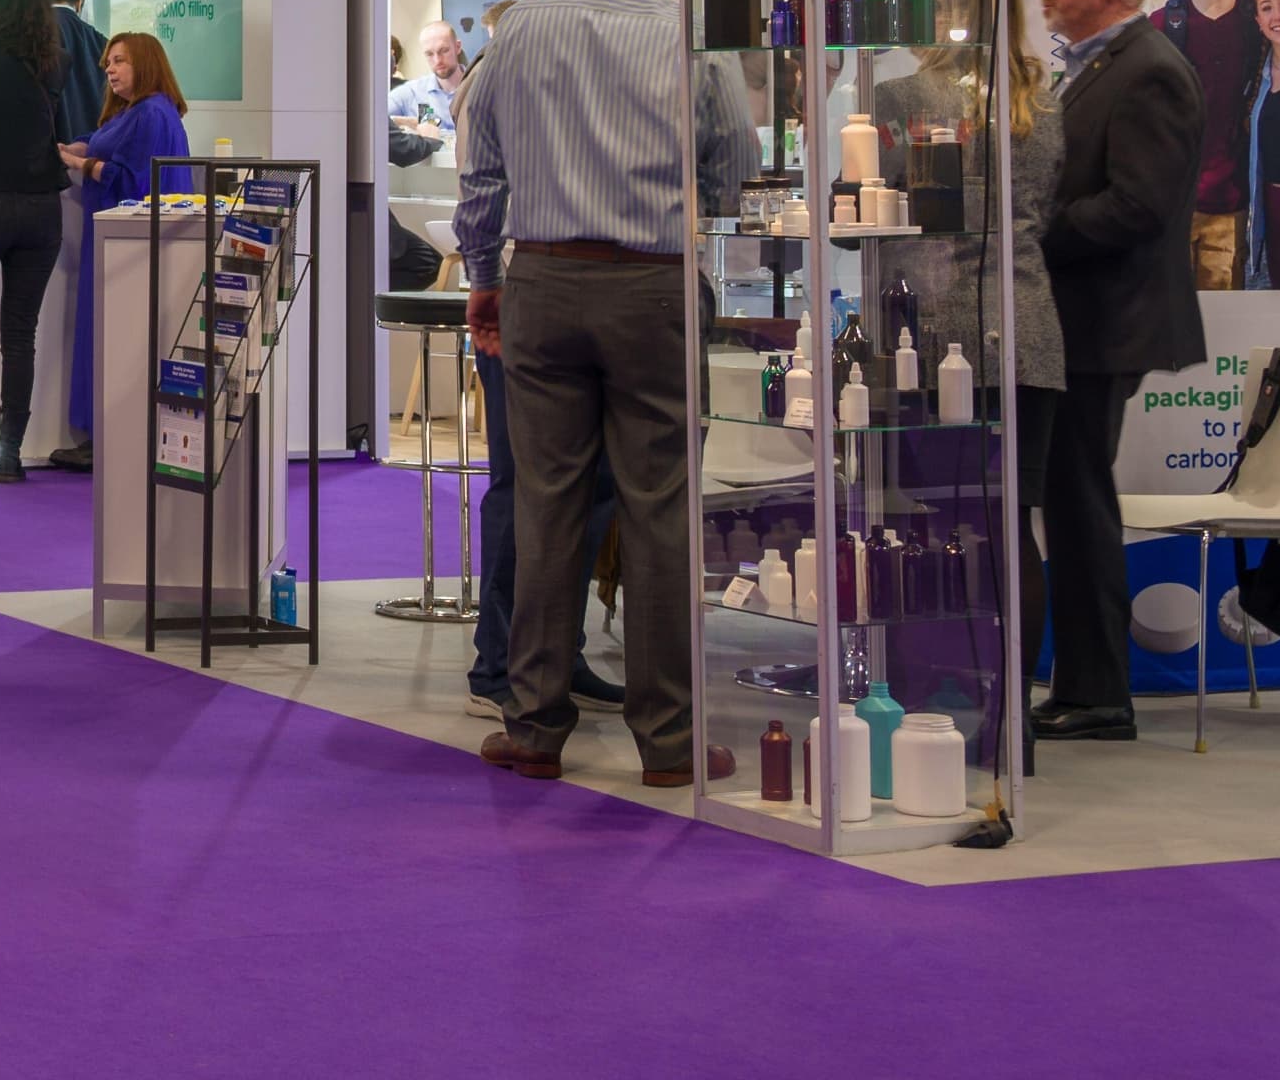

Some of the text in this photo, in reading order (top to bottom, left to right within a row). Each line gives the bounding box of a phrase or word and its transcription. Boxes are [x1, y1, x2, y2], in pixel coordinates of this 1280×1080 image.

[189, 0, 214, 20] filling
[1144, 384, 1243, 413] packagi
[1202, 418, 1226, 438] to
